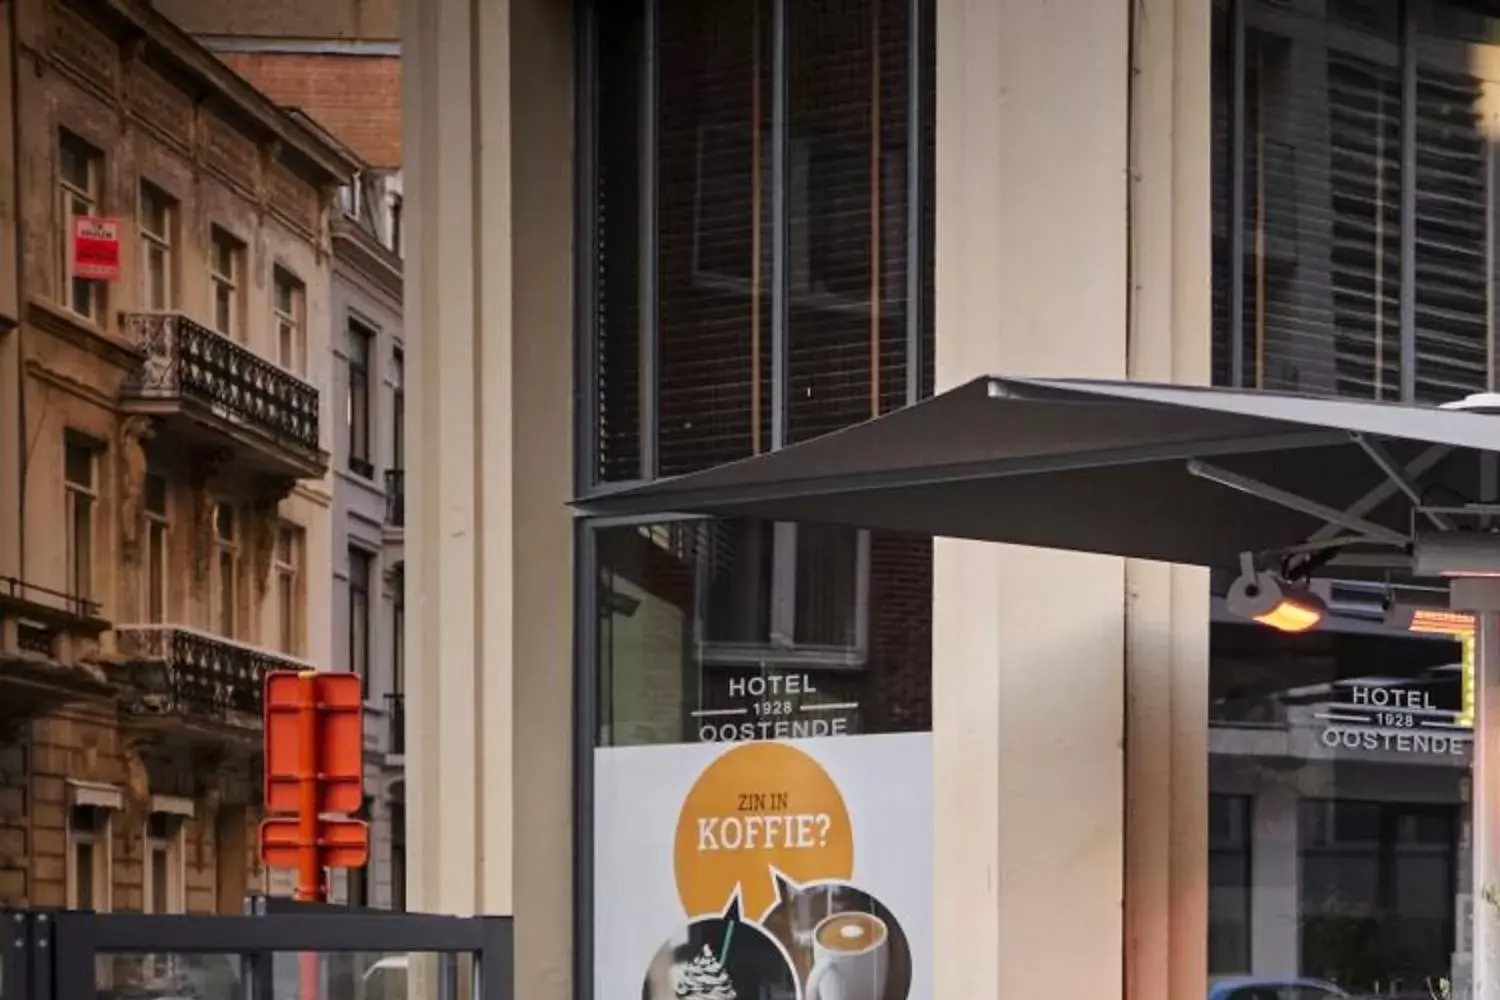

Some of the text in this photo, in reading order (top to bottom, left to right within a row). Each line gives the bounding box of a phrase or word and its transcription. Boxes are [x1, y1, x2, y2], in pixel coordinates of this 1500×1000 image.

[729, 674, 817, 697] HOTEL
[753, 701, 793, 716] 1928
[1352, 686, 1437, 710] HOTEL
[700, 718, 848, 743] OOSTENDE
[1376, 713, 1414, 727] 1928
[1322, 728, 1464, 755] OOSTENDE
[738, 792, 788, 811] ZIN IN
[697, 813, 831, 851] KOFFIE?
